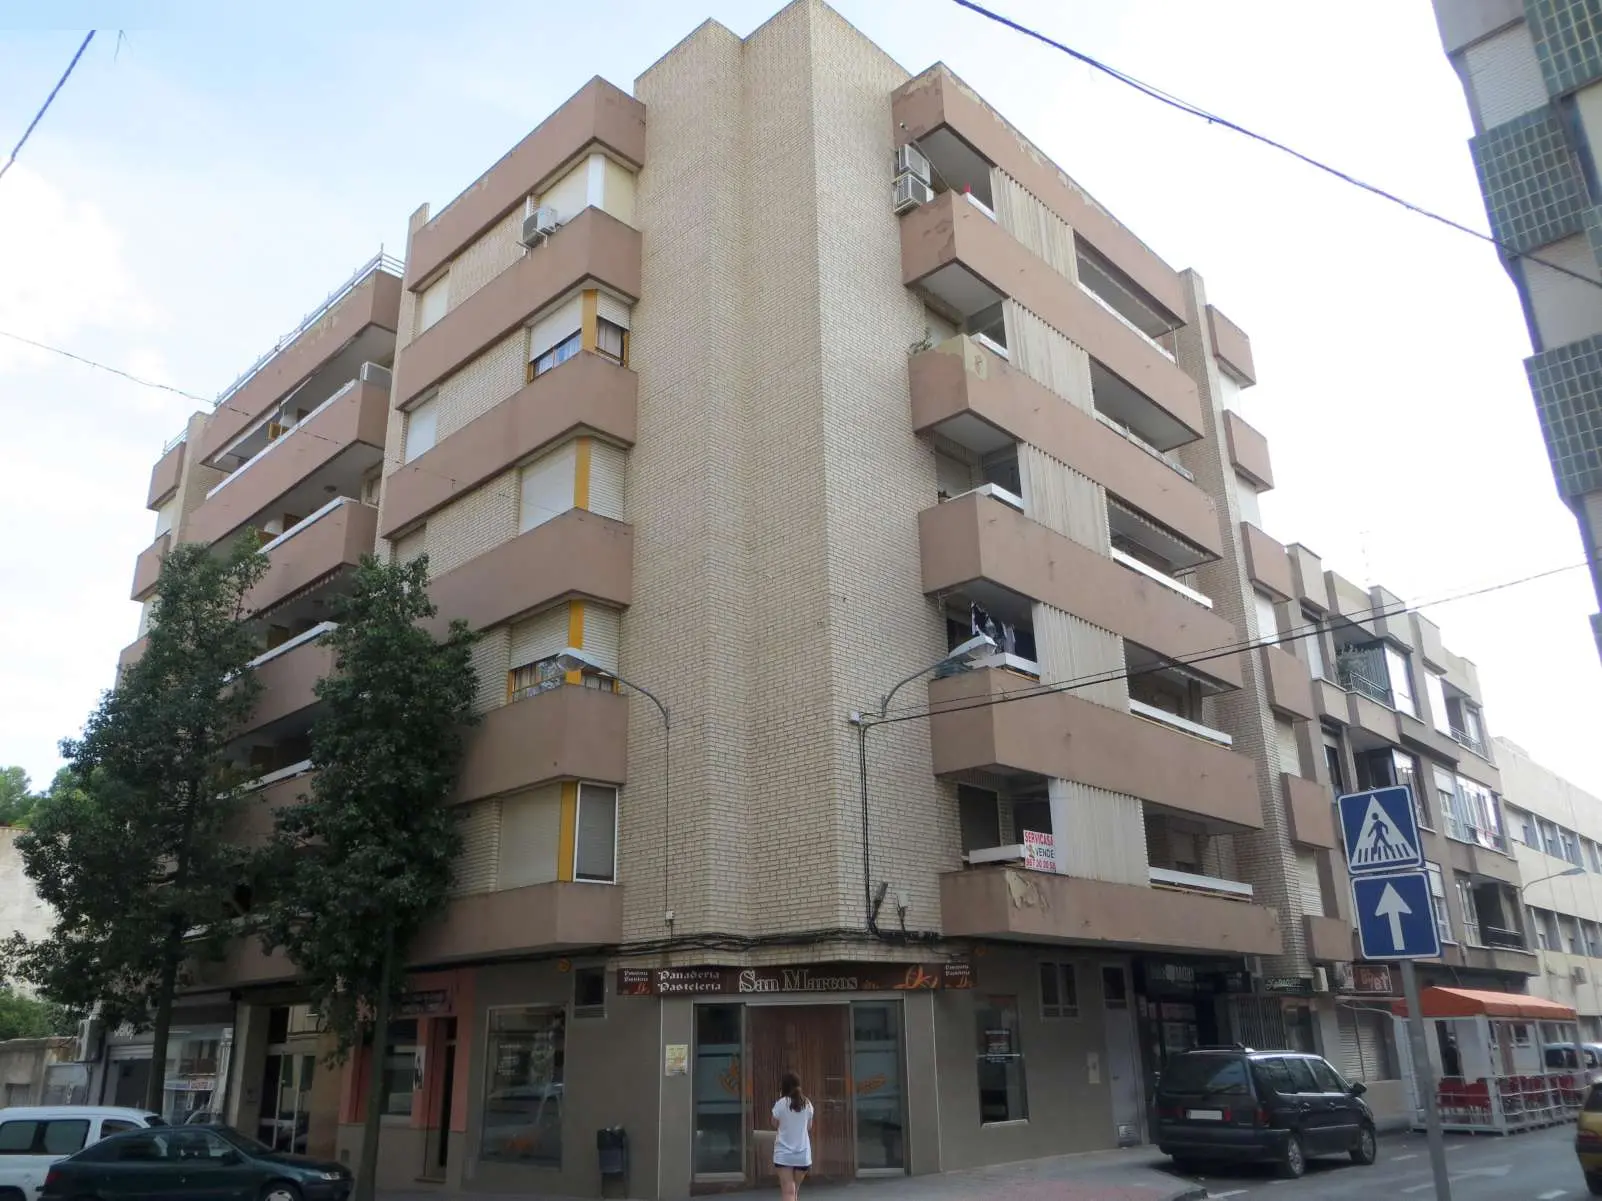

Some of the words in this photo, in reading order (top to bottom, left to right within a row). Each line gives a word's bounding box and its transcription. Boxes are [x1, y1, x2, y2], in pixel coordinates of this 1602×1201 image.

[1034, 847, 1056, 859] VENDE
[739, 969, 780, 993] San
[782, 969, 858, 992] Marcos
